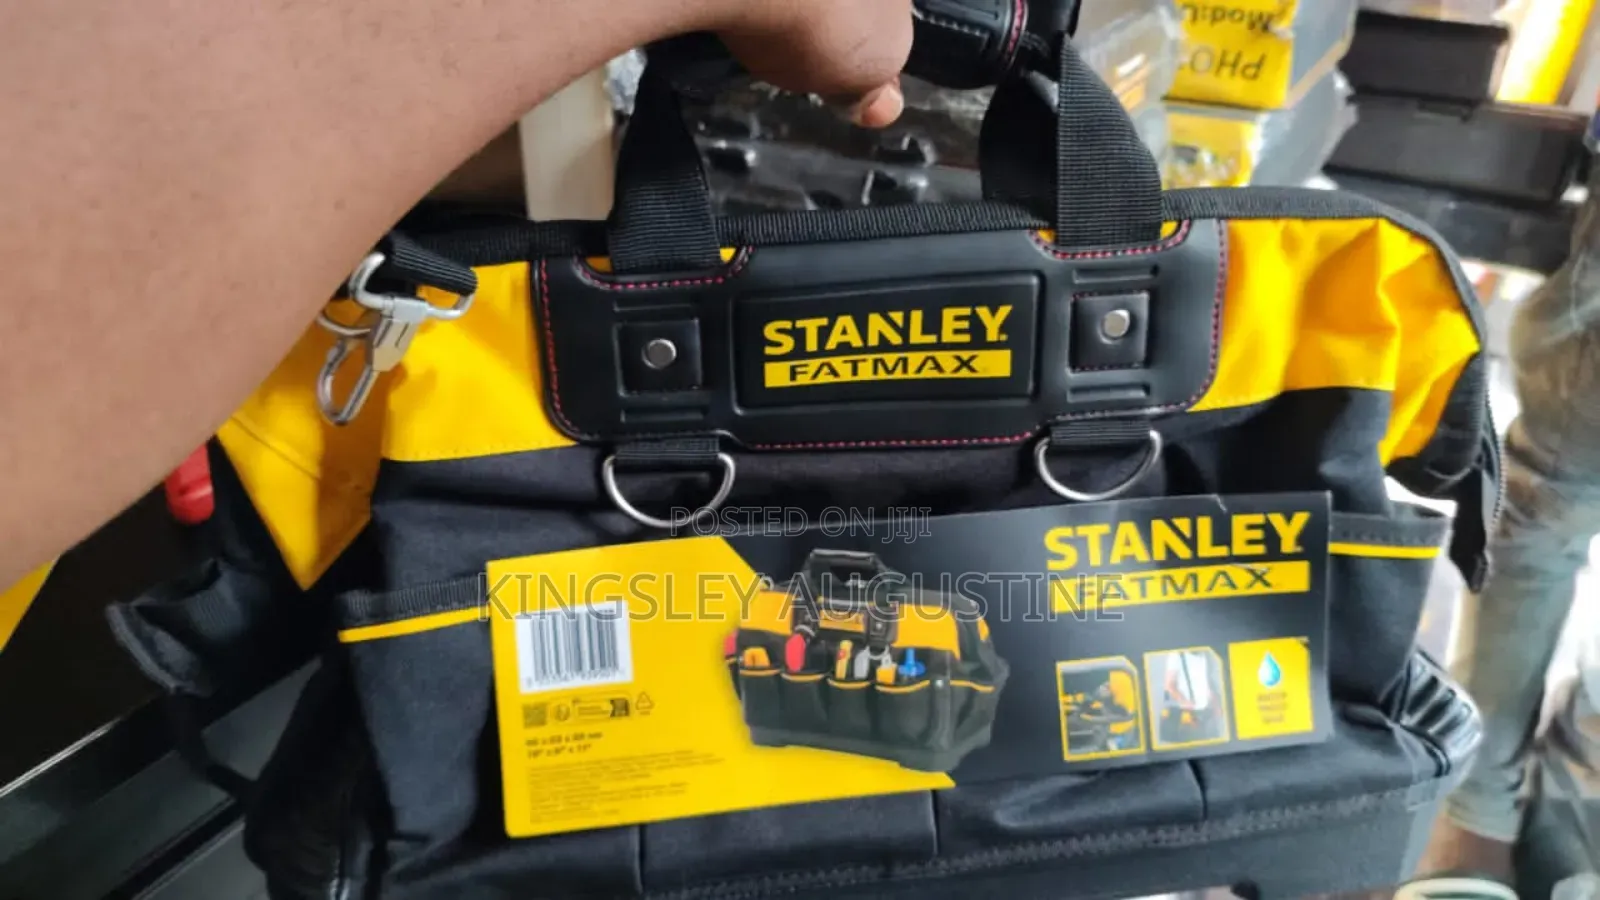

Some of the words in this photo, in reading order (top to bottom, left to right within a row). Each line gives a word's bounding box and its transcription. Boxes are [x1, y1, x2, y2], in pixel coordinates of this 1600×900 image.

[764, 305, 1012, 355] STANLEY
[789, 355, 980, 383] FATMAX
[1044, 512, 1310, 571] STANLEY
[1075, 568, 1275, 602] FATMAX
